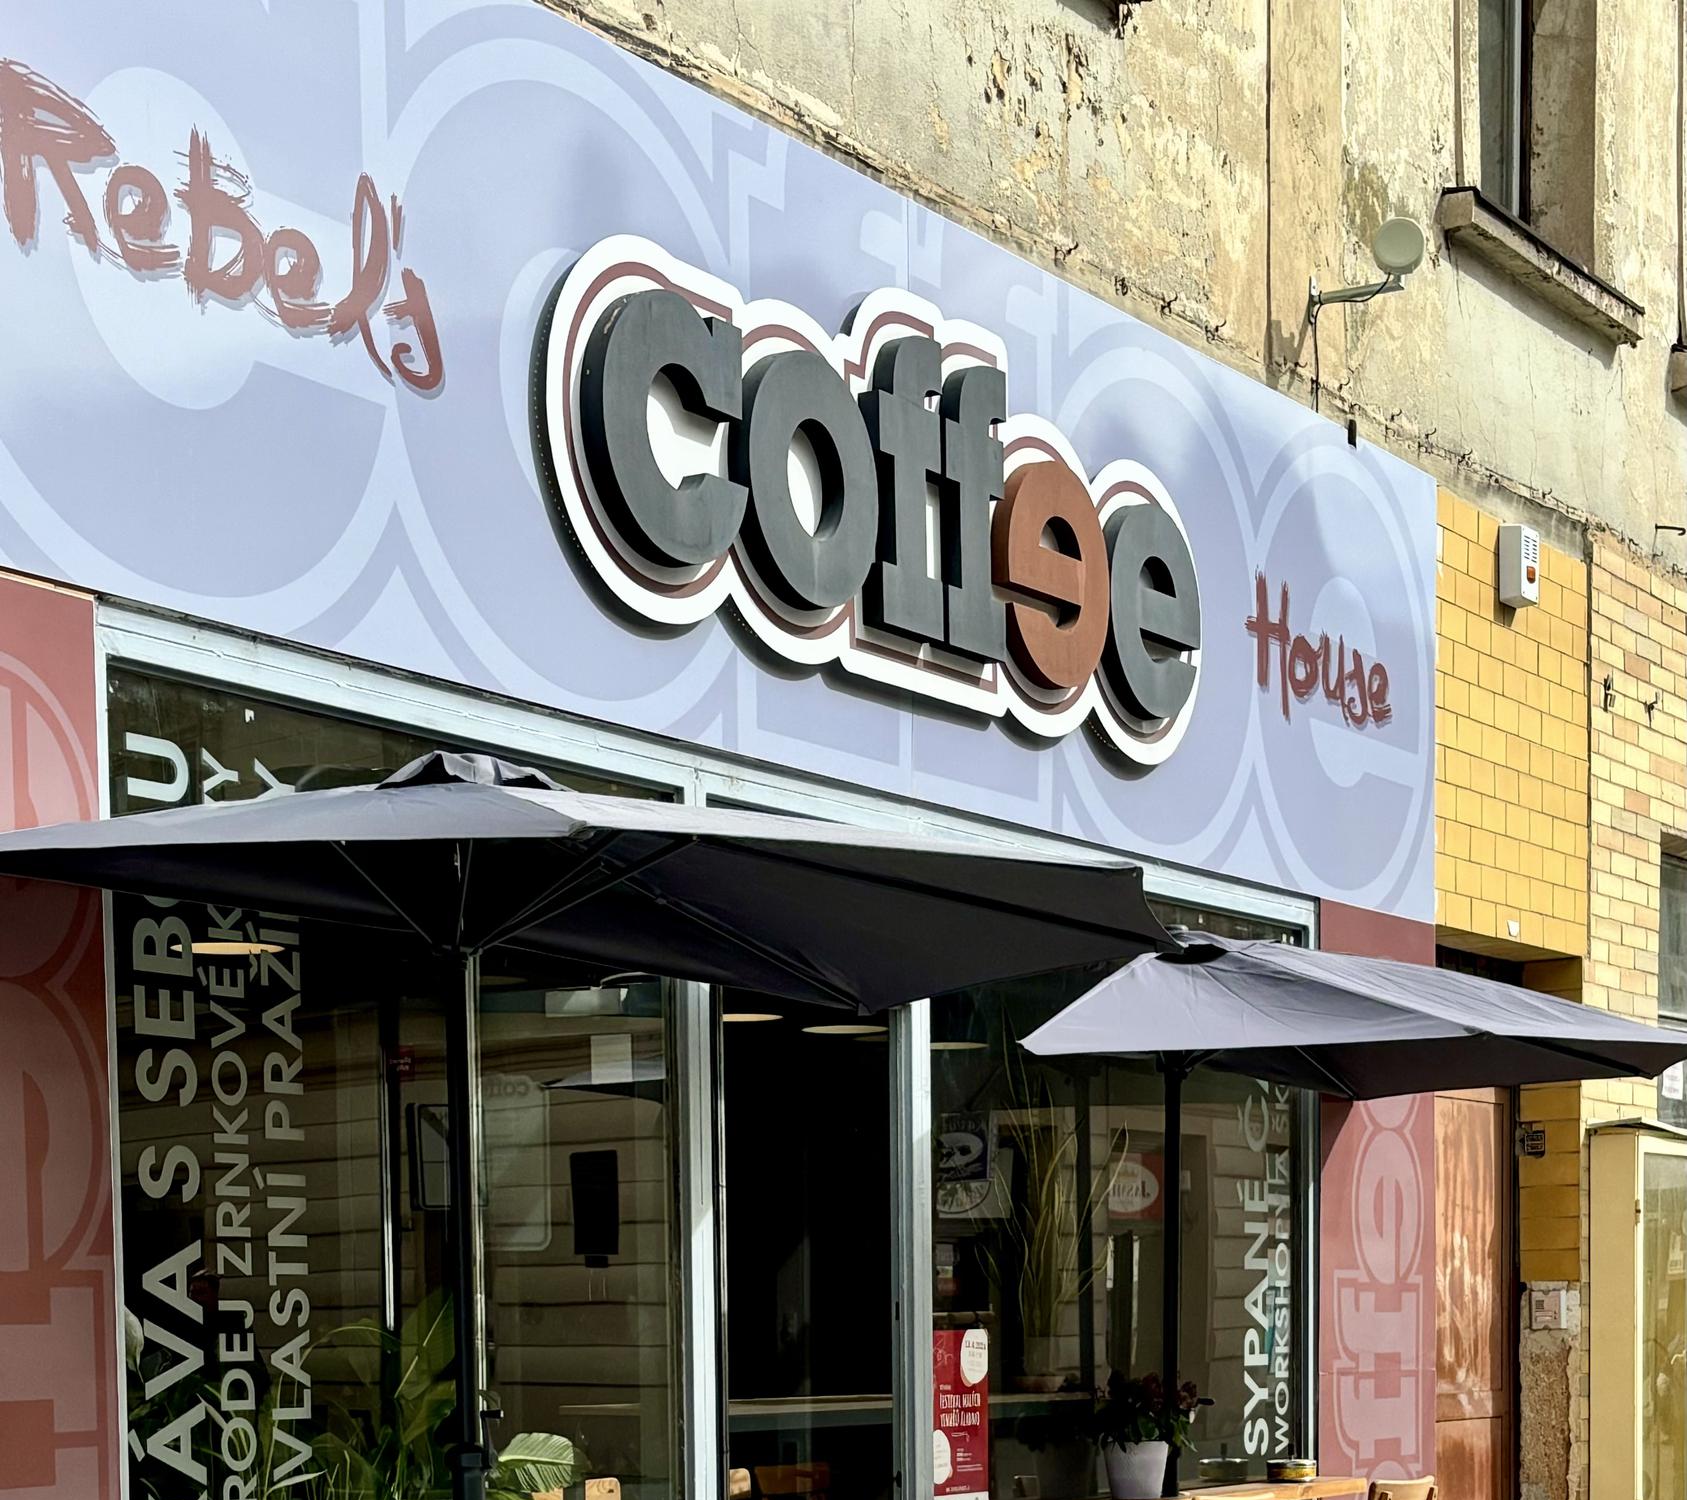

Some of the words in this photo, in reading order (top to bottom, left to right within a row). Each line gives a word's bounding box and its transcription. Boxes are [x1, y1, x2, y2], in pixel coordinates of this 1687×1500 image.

[572, 280, 1202, 726] coffee
[1244, 565, 1394, 728] House
[126, 731, 199, 1108] SEBU
[138, 1144, 201, 1204] S
[197, 965, 252, 1277] ZRNKOVÉ
[252, 1172, 313, 1483] VLASTNÍ
[1238, 1178, 1270, 1457] SYPANÉ
